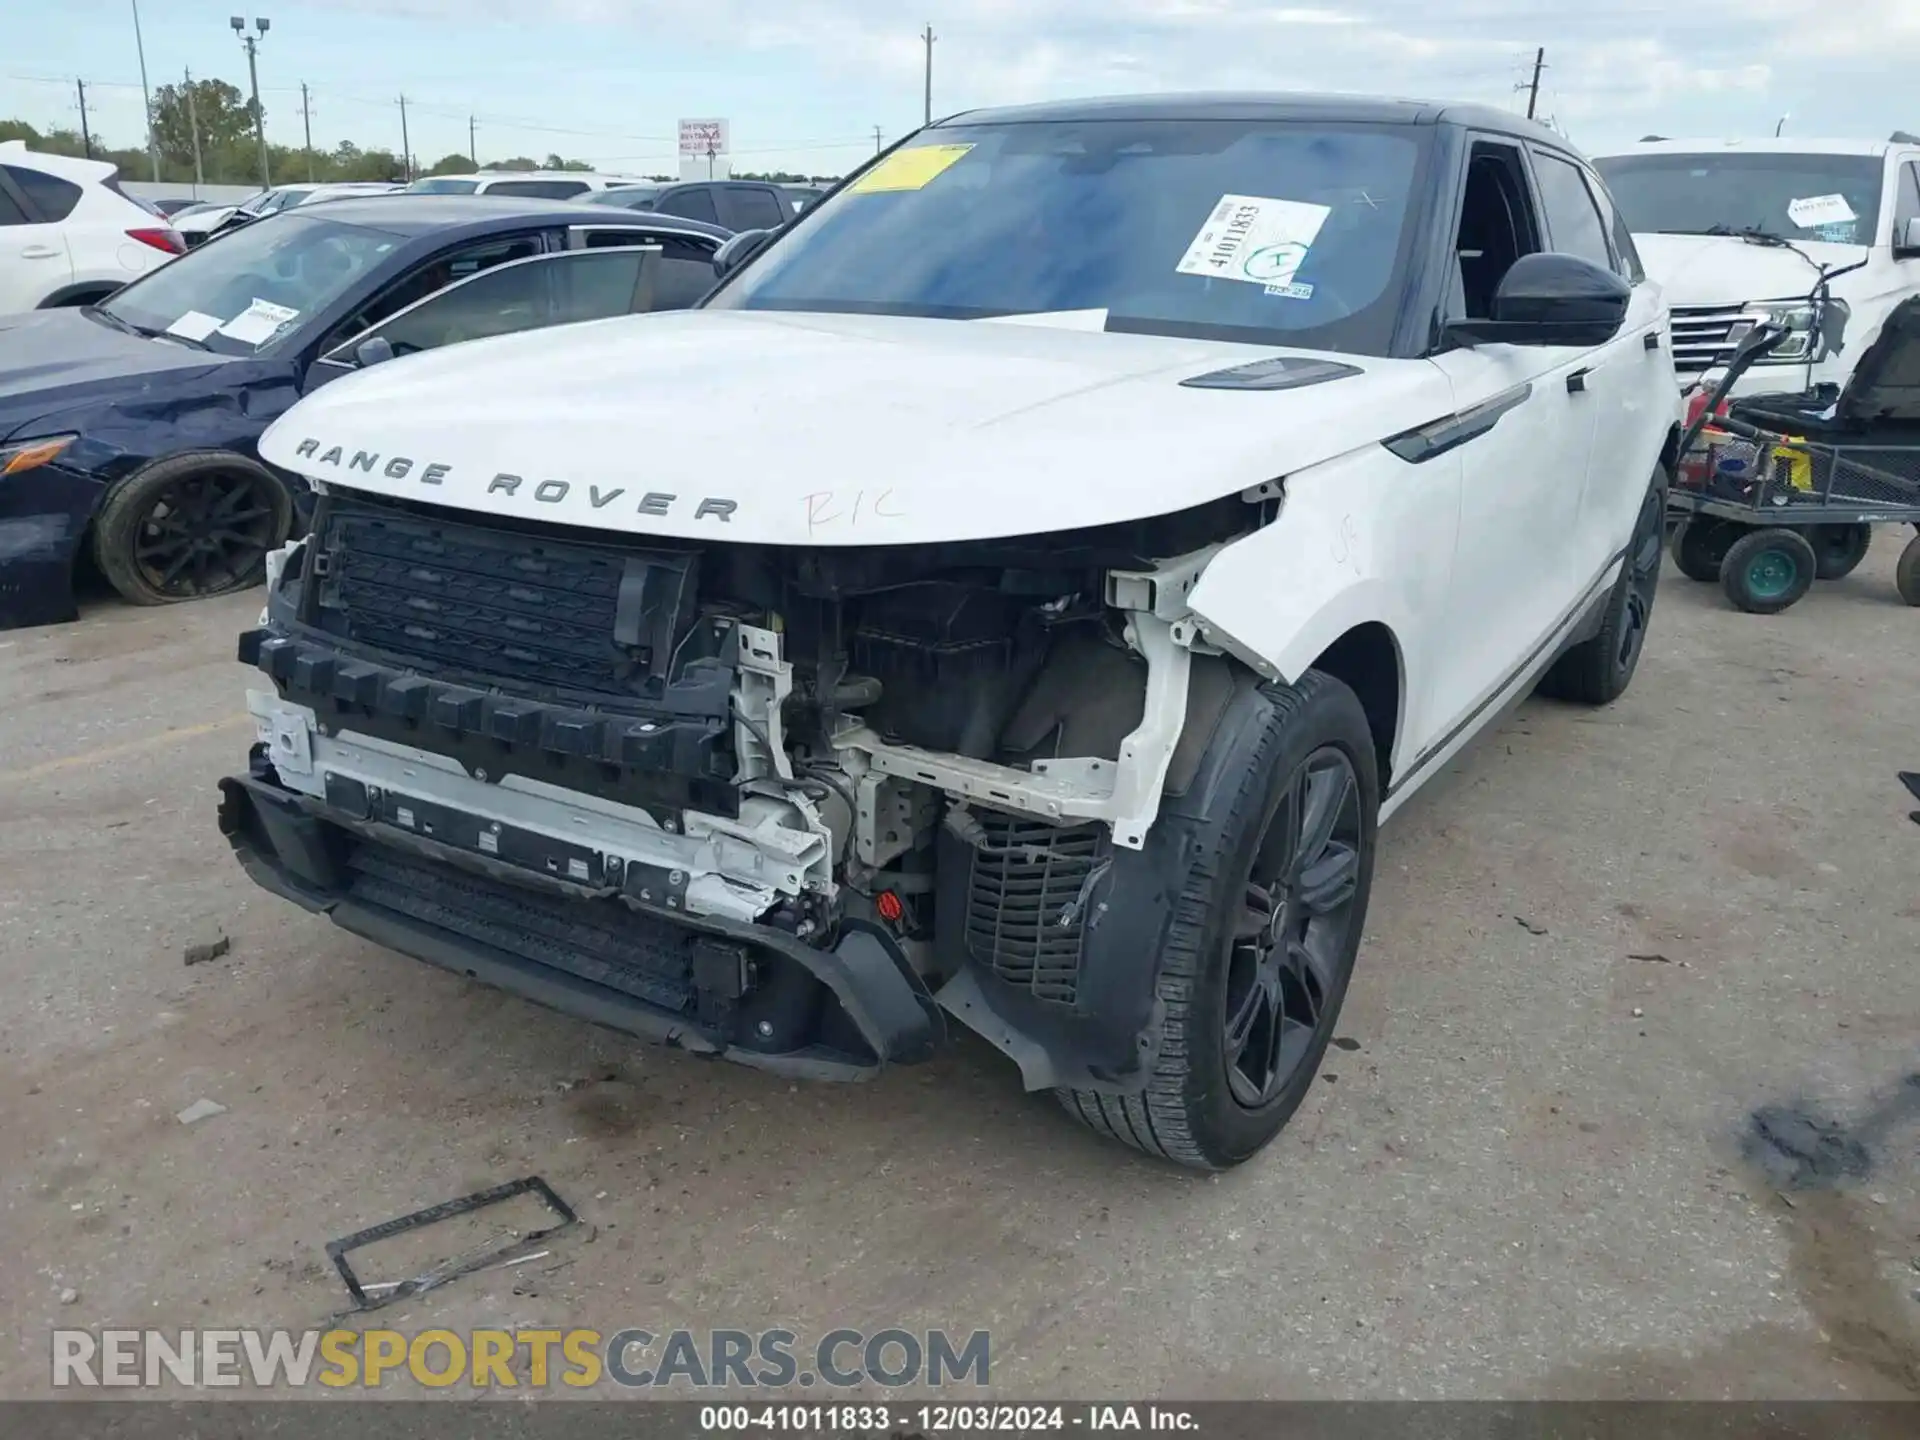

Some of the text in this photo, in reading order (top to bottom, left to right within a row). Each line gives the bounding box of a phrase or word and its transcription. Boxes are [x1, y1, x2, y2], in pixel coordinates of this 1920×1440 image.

[1208, 206, 1259, 268] 41011833
[296, 438, 738, 522] RANGE ROVER
